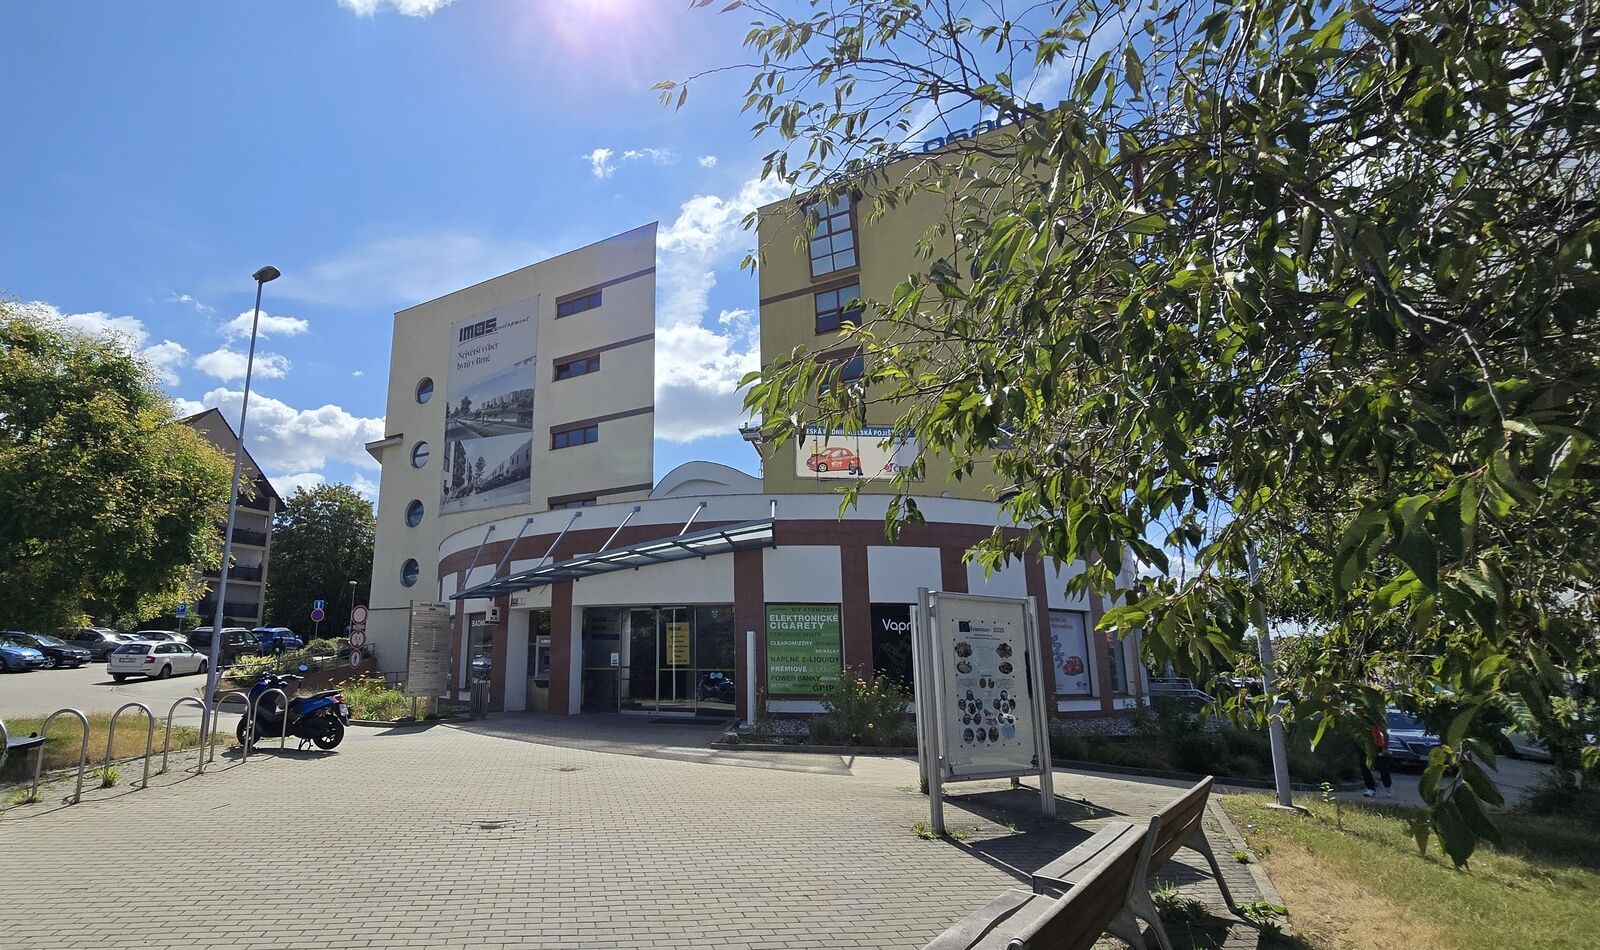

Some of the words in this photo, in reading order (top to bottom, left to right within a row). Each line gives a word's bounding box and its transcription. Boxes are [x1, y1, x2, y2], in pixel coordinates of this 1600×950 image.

[459, 317, 497, 342] IMOS
[769, 614, 839, 622] ELEKTRONICKÉ
[769, 621, 825, 630] CIGARETY
